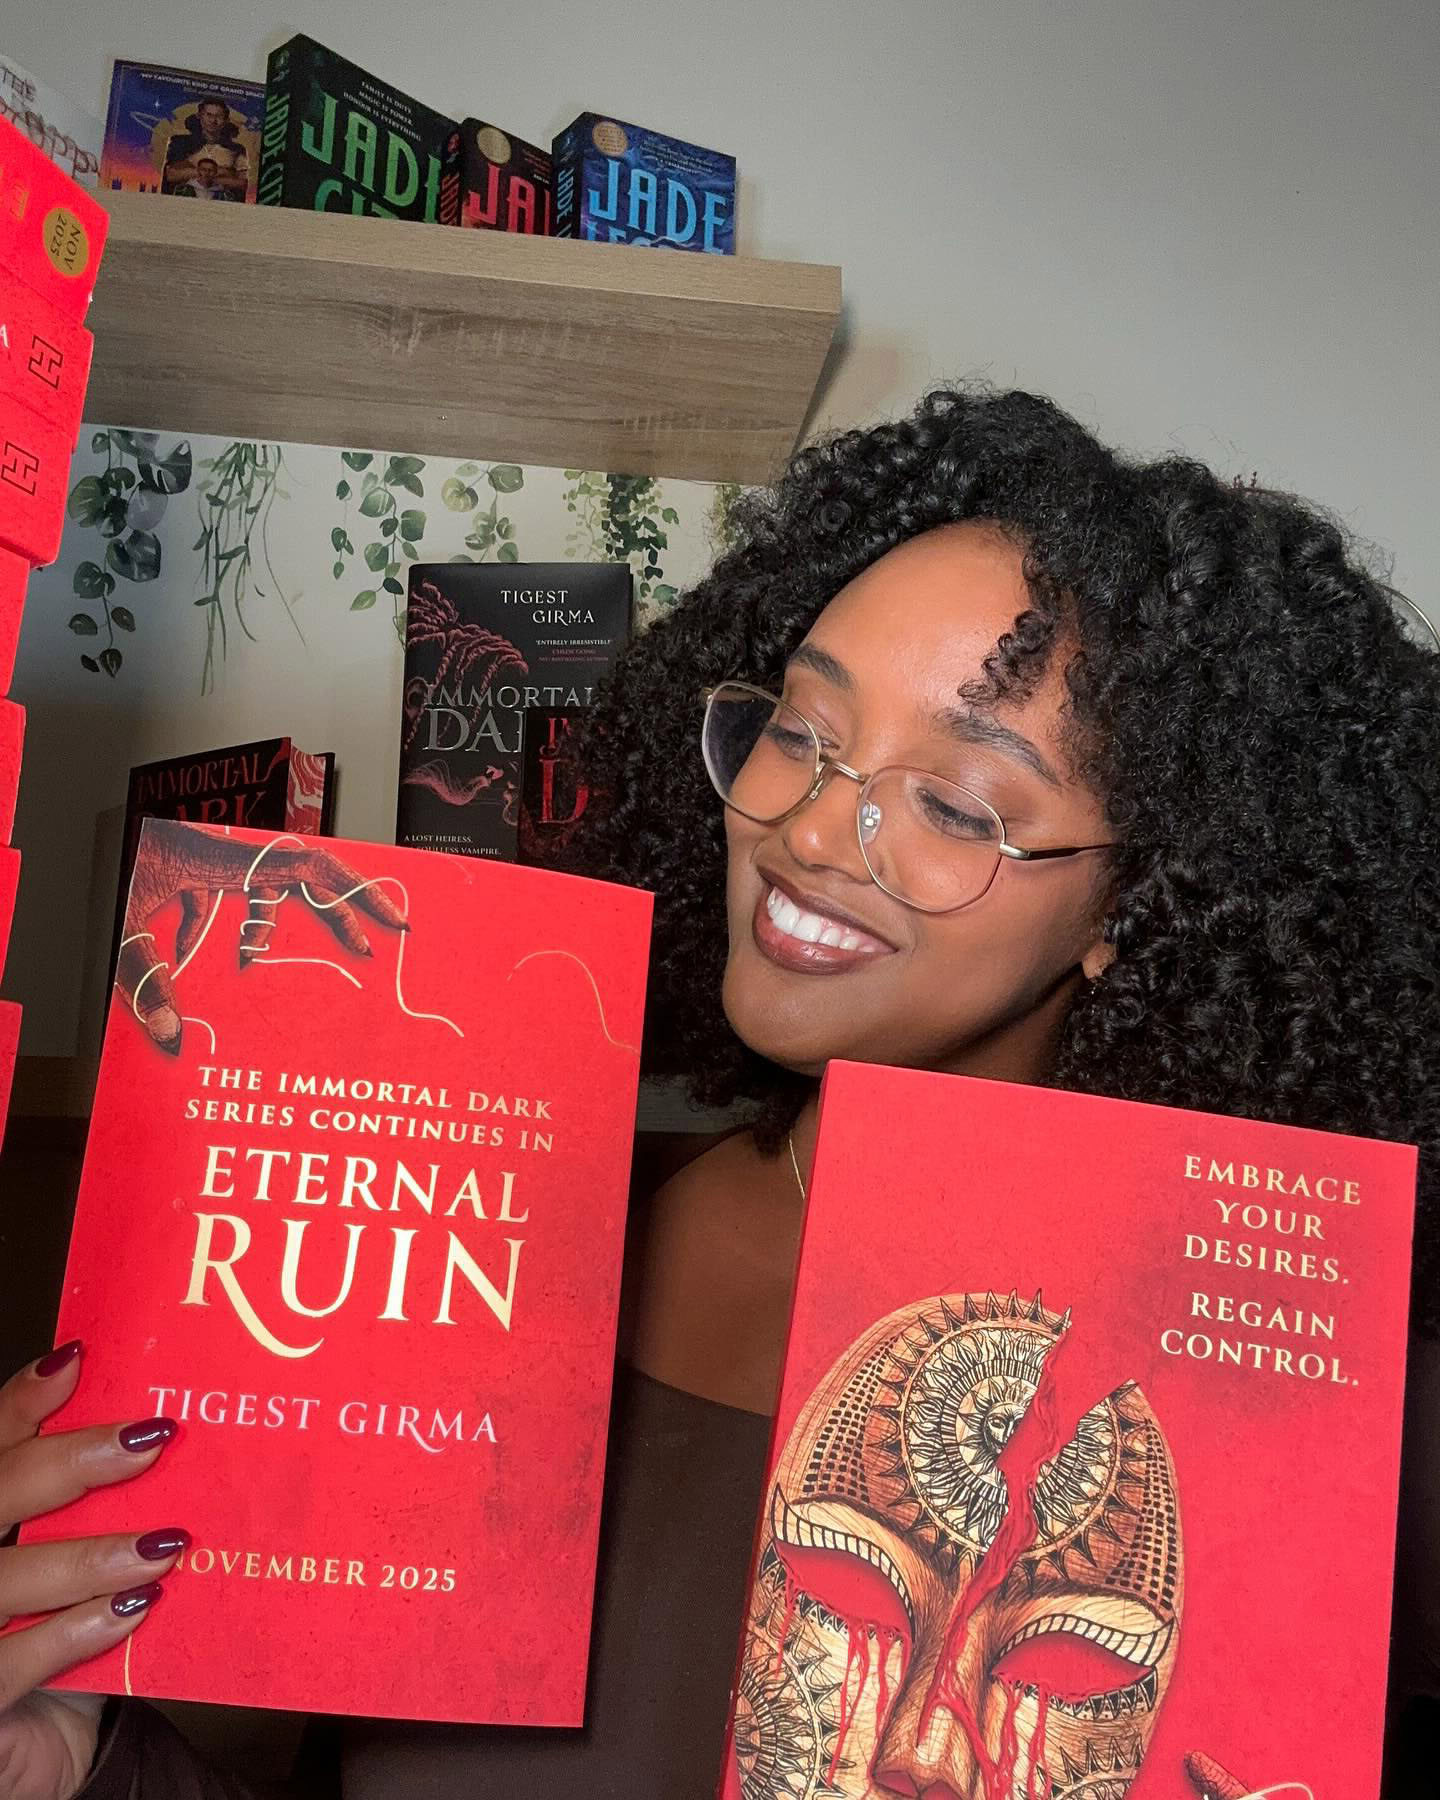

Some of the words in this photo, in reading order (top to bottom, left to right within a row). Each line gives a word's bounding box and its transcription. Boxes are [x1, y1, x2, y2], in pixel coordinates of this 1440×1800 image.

[557, 167, 575, 224] JADE
[587, 158, 728, 256] JADE
[50, 213, 67, 256] 2025
[64, 224, 81, 271] NOV
[500, 590, 569, 604] TIGEST
[532, 609, 595, 627] GIRMA
[137, 752, 268, 803] IMMORTAL
[411, 834, 433, 843] LOST
[198, 1066, 263, 1091] THE
[278, 1072, 453, 1109] IMMORTAL
[466, 1091, 554, 1120] DARK
[184, 1099, 295, 1127] SERIES
[309, 1109, 505, 1147] CONTINUES
[519, 1130, 555, 1153] IN
[199, 1145, 530, 1224] ETERNAL
[1184, 1154, 1362, 1206] EMBRACE
[1214, 1199, 1326, 1241] YOUR
[1184, 1234, 1350, 1285] DESIRES.
[180, 1212, 527, 1359] RUIN
[1190, 1292, 1335, 1340] REGAIN
[1160, 1329, 1360, 1387] CONTROL.
[149, 1387, 321, 1430] TIGEST
[338, 1402, 499, 1454] GIRMA
[379, 1565, 457, 1592] 2025
